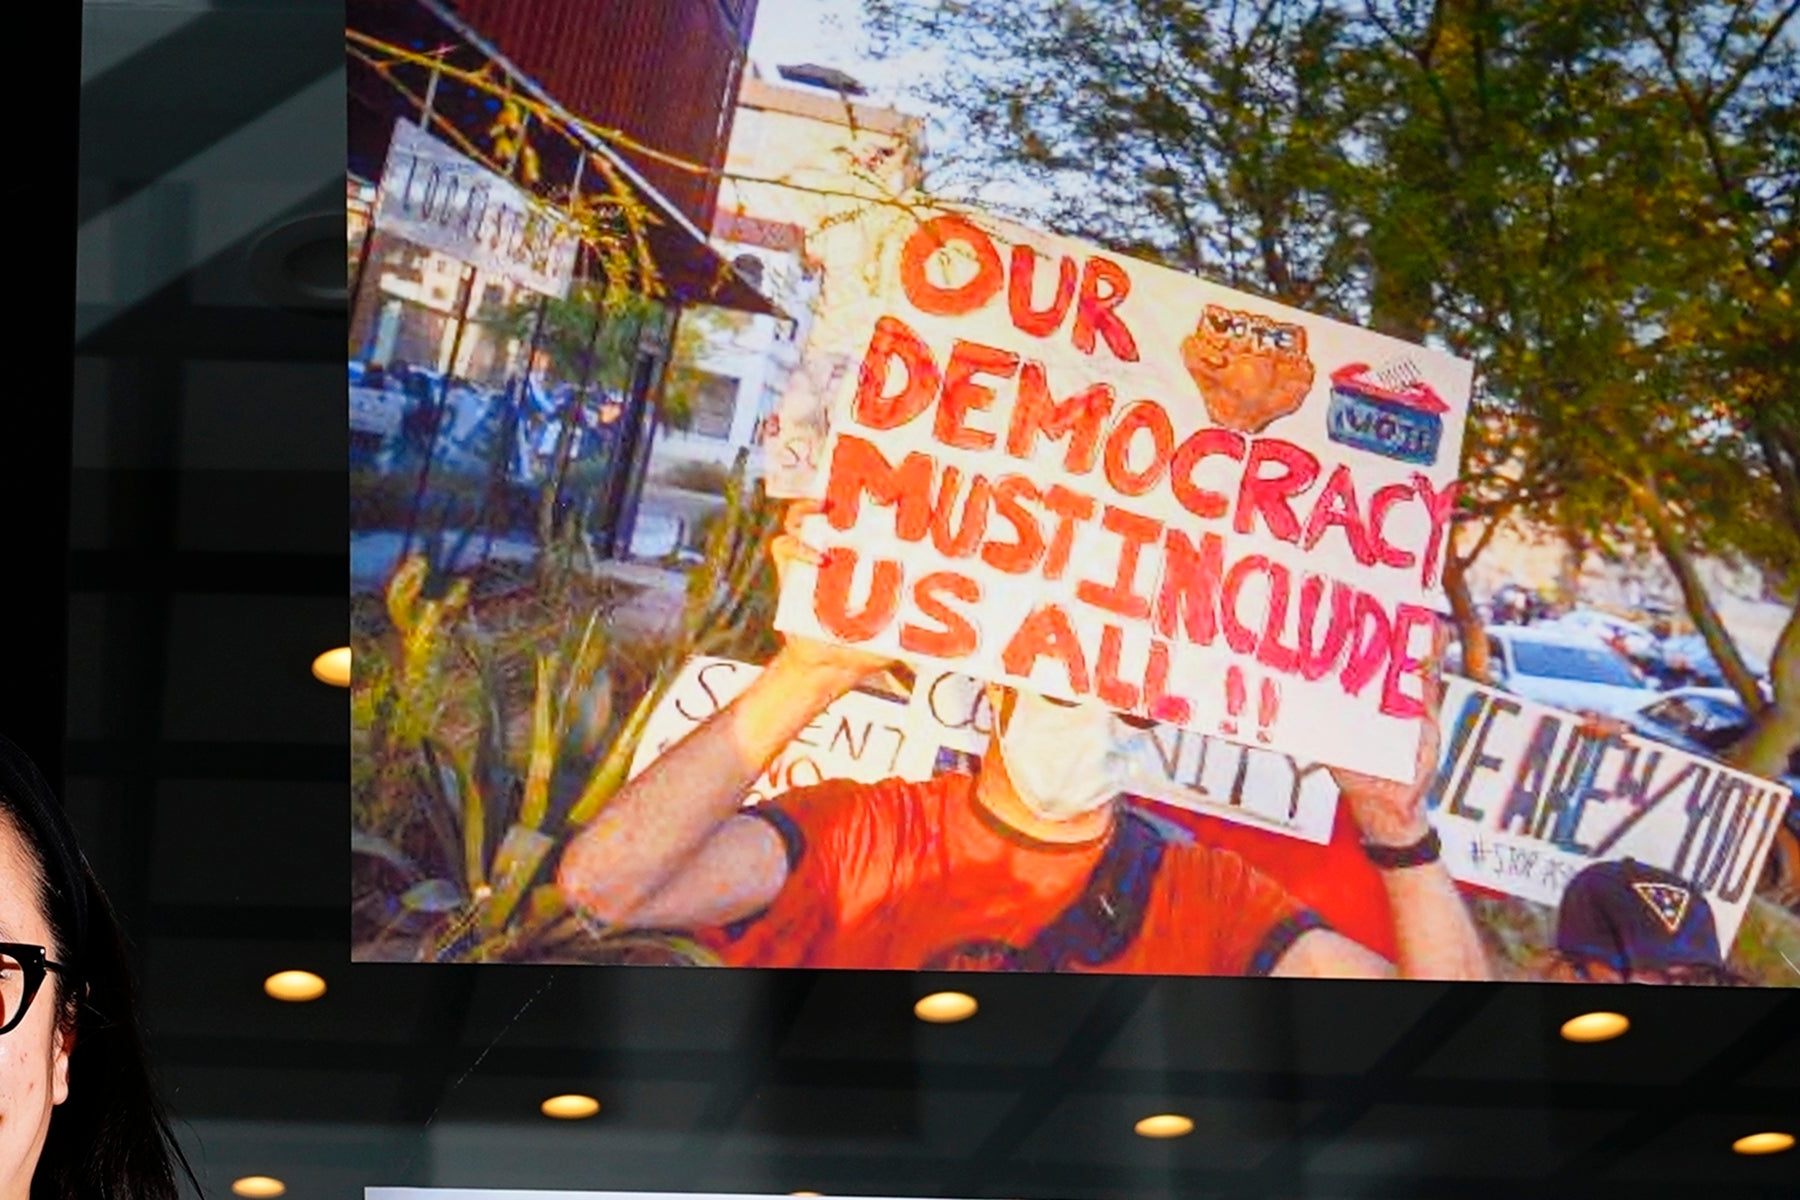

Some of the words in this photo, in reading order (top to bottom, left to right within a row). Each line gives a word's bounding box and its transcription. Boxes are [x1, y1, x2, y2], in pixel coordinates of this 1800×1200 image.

[899, 215, 1140, 363] OUR
[1207, 313, 1295, 348] VOTE
[852, 314, 1464, 592] DEMOCRACY
[812, 546, 982, 658] US
[826, 432, 1094, 580] MUST
[1075, 507, 1442, 720] INCLUDE
